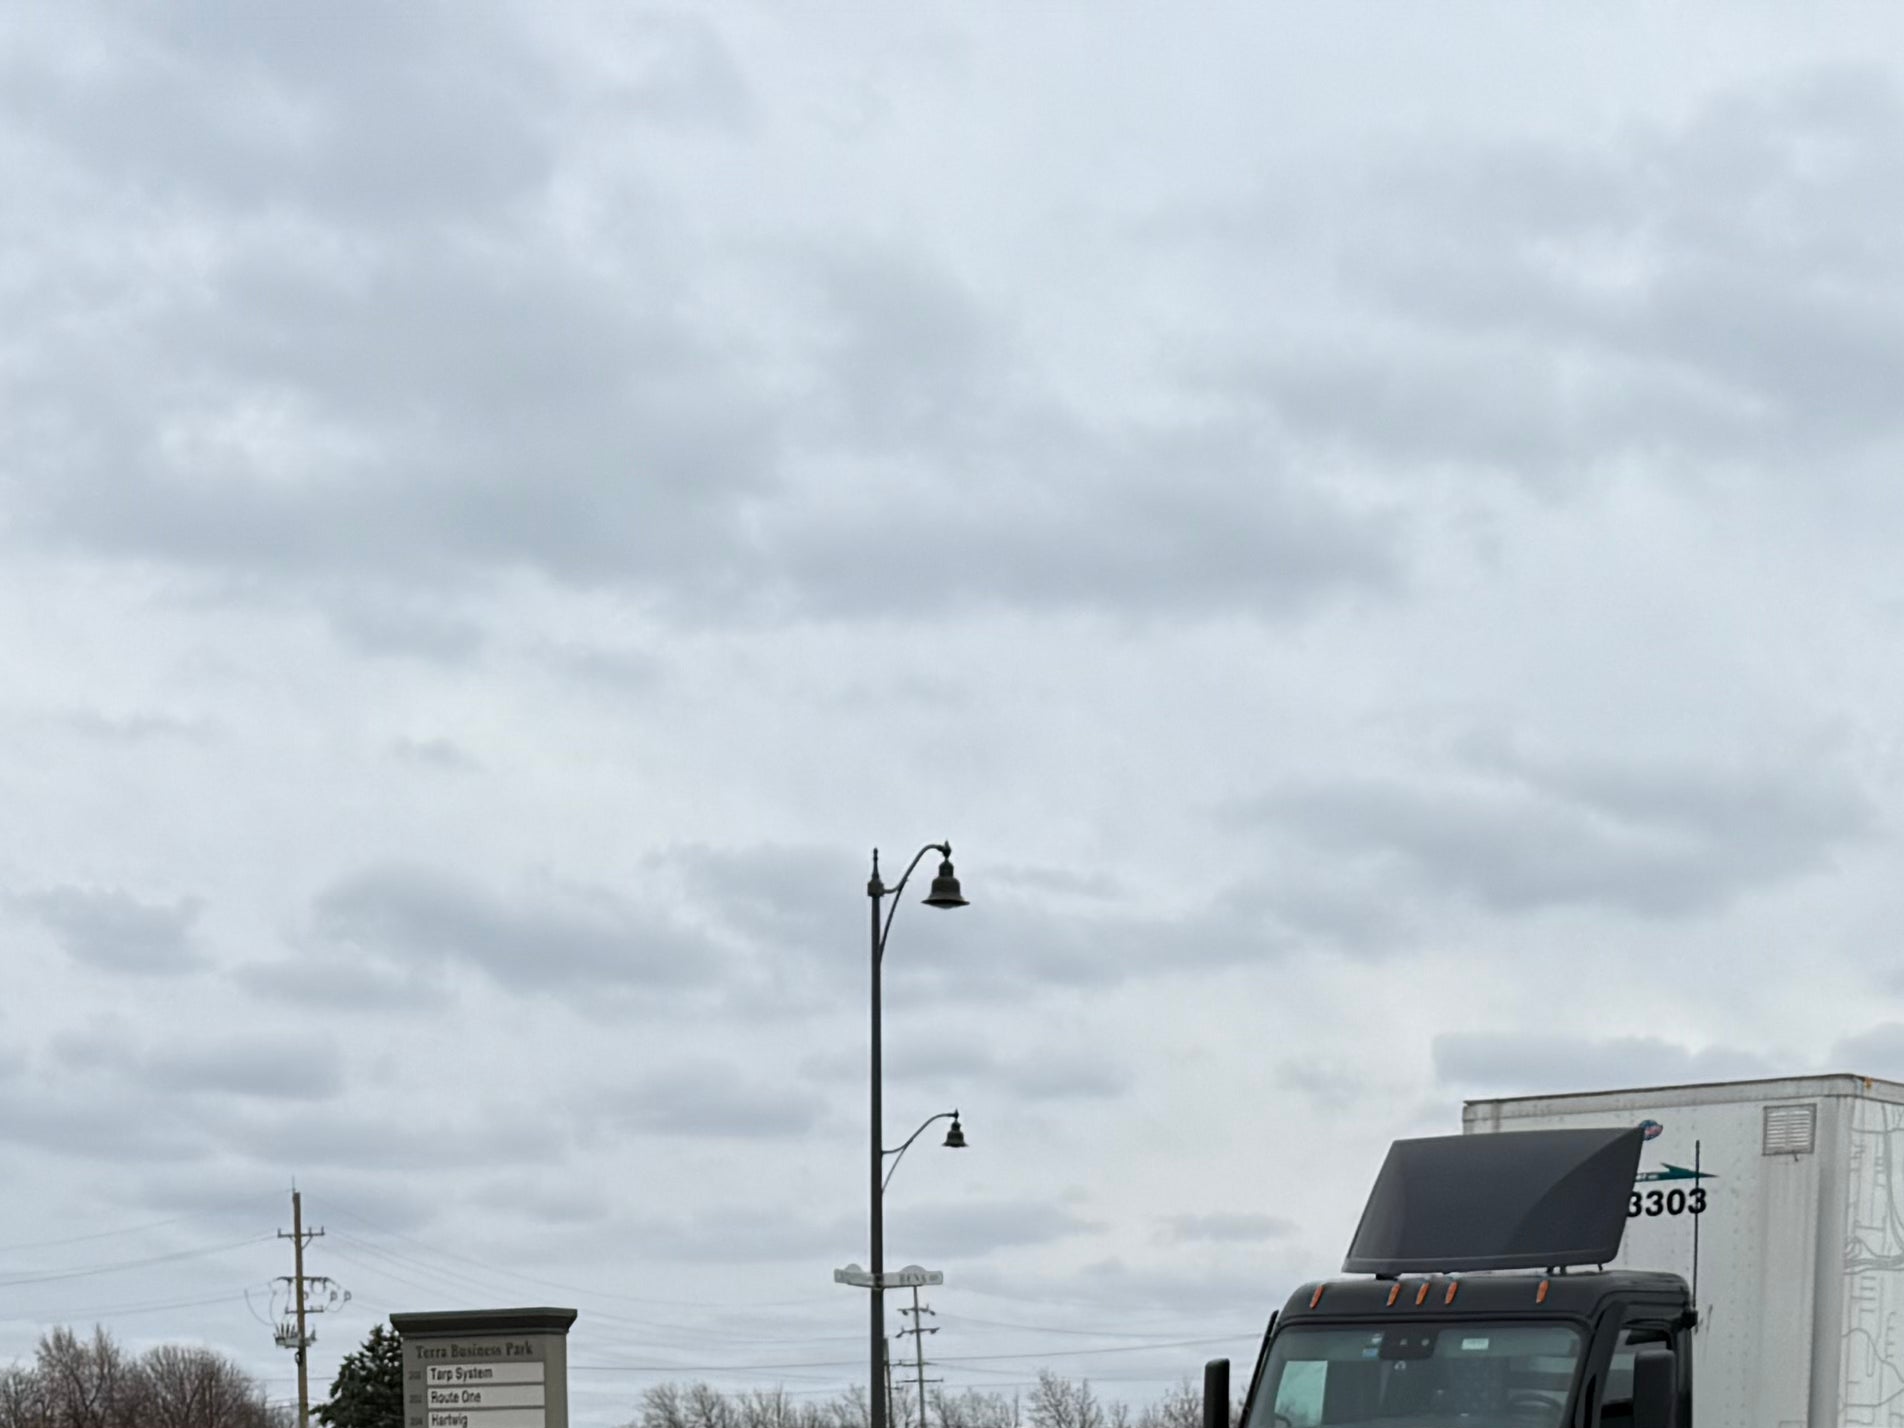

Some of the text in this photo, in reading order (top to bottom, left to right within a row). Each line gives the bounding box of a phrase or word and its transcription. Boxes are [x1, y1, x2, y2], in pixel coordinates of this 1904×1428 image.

[416, 1340, 534, 1359] Terra Business Park
[430, 1367, 453, 1381] Tarp
[456, 1366, 494, 1381] System
[431, 1390, 459, 1404] Route
[461, 1389, 482, 1404] One
